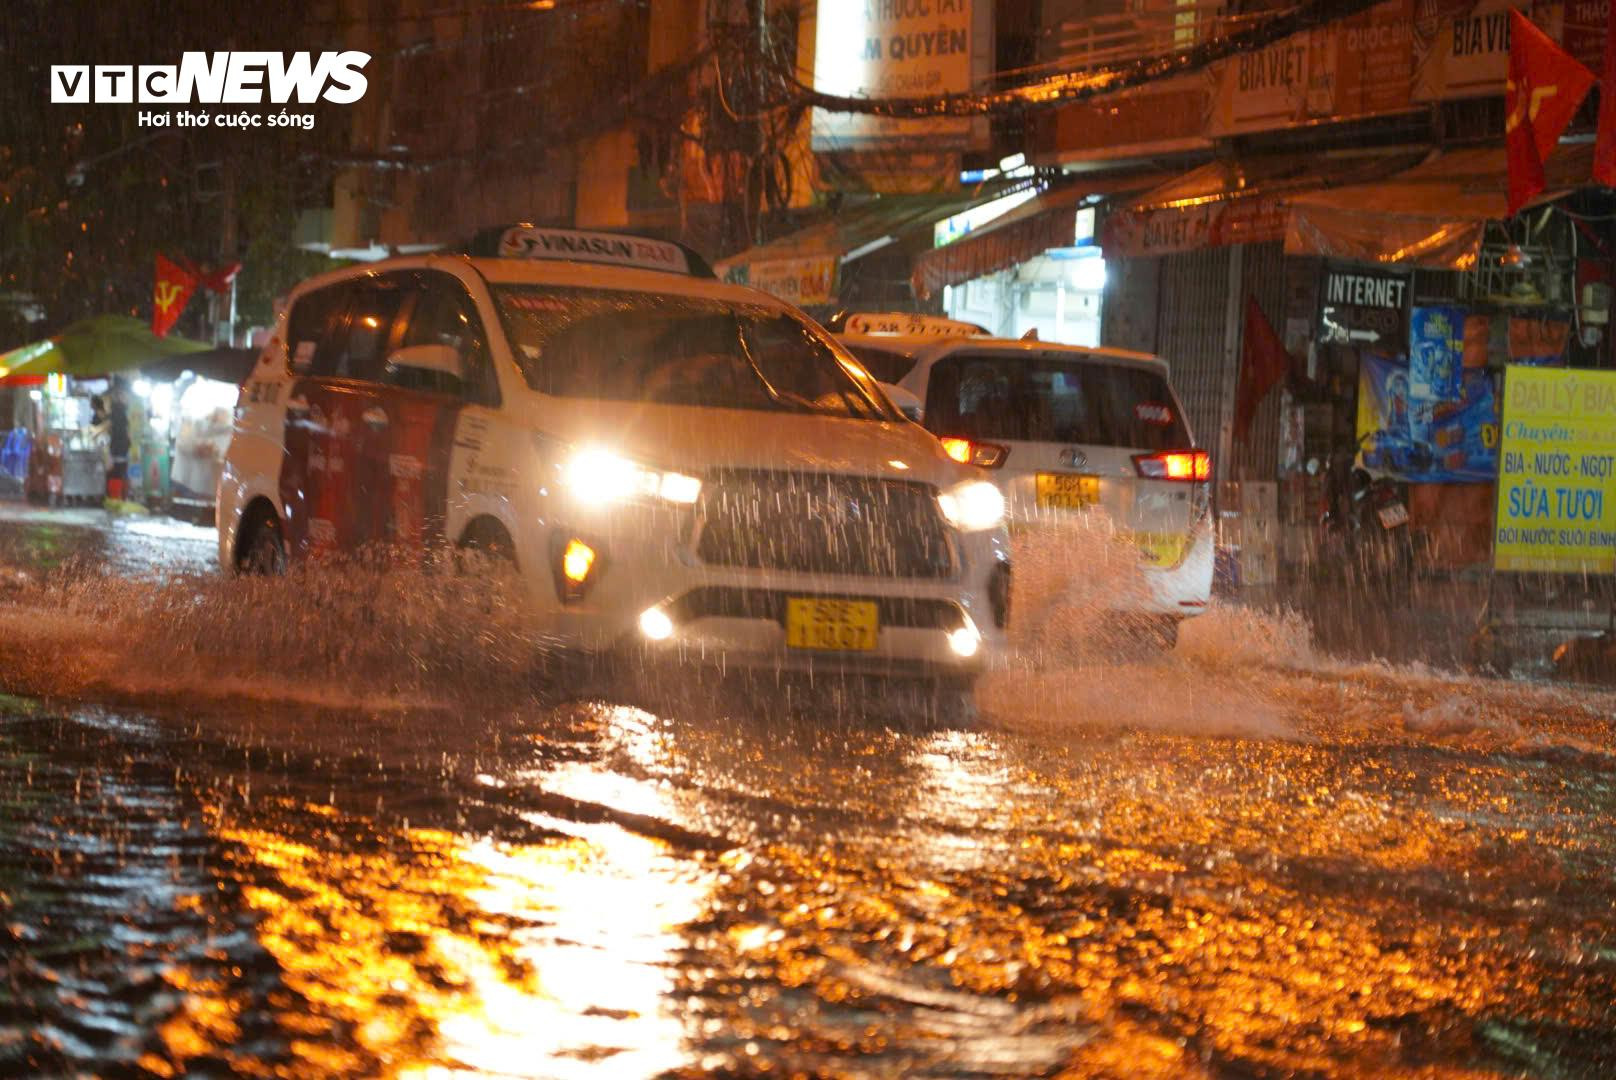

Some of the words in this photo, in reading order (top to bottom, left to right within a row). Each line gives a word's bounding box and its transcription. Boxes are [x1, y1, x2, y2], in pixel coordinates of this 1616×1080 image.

[540, 234, 633, 258] VINASUN
[1327, 273, 1405, 309] INTERNET
[1504, 452, 1525, 475] BIA
